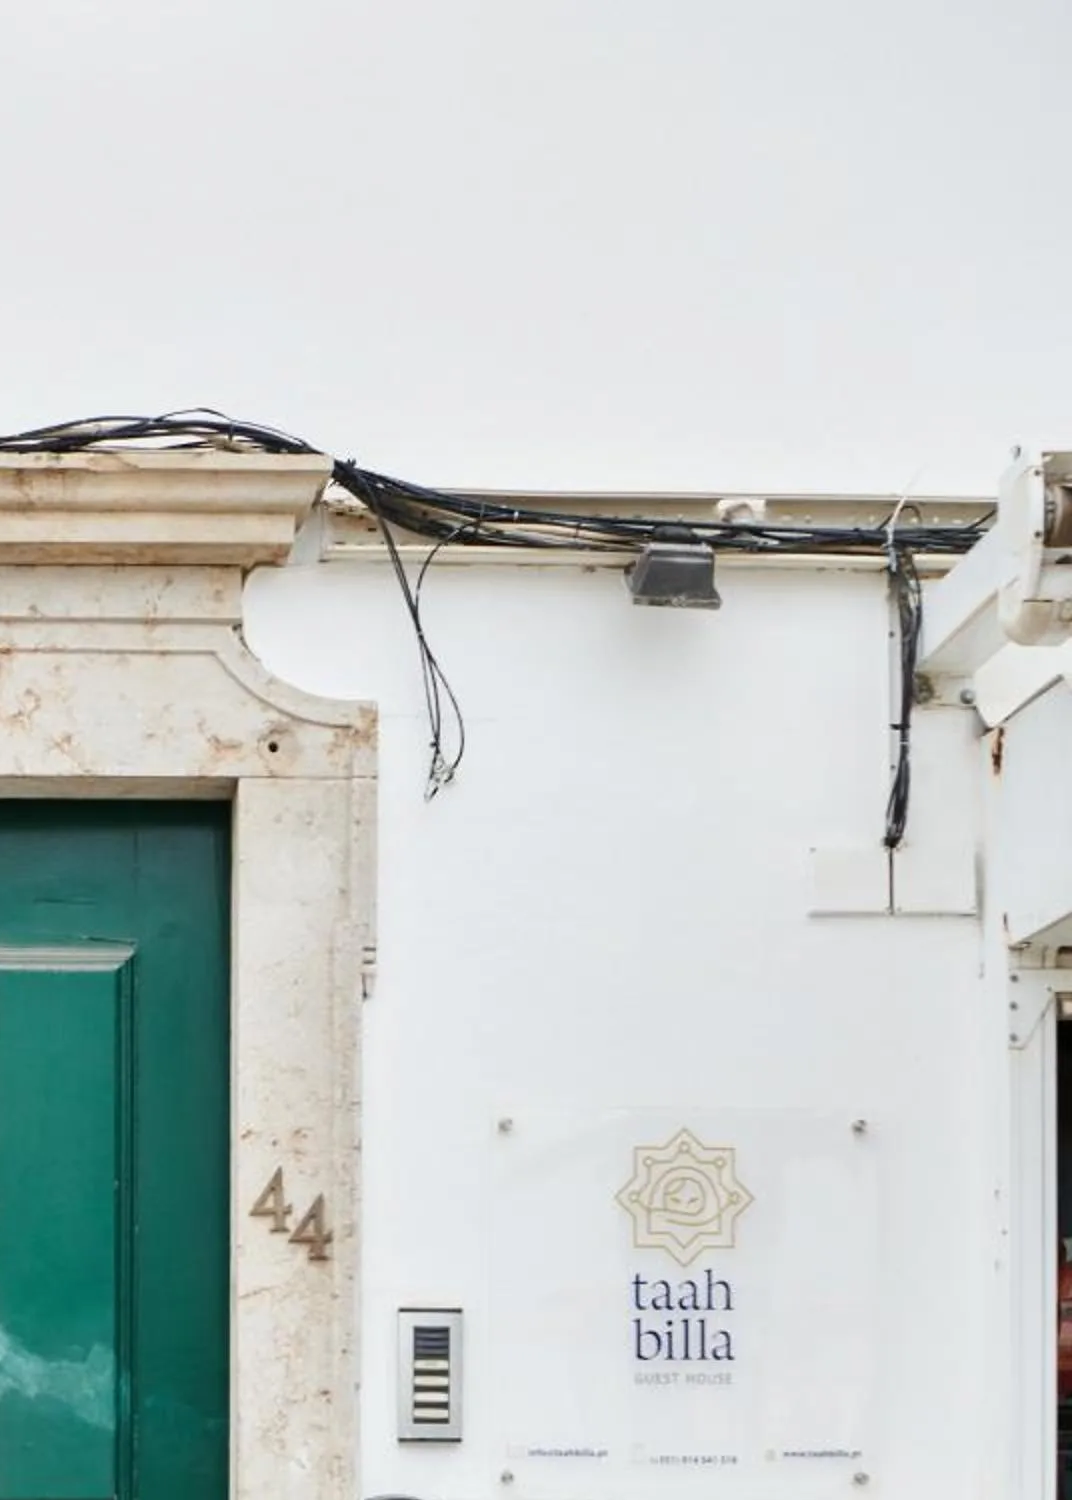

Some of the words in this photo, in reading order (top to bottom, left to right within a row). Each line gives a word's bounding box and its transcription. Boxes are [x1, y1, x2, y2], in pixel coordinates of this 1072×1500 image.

[248, 1165, 334, 1261] 44
[631, 1268, 734, 1310] taah
[632, 1318, 735, 1360] billa
[634, 1372, 680, 1385] GUEST
[685, 1372, 733, 1385] HOUSE
